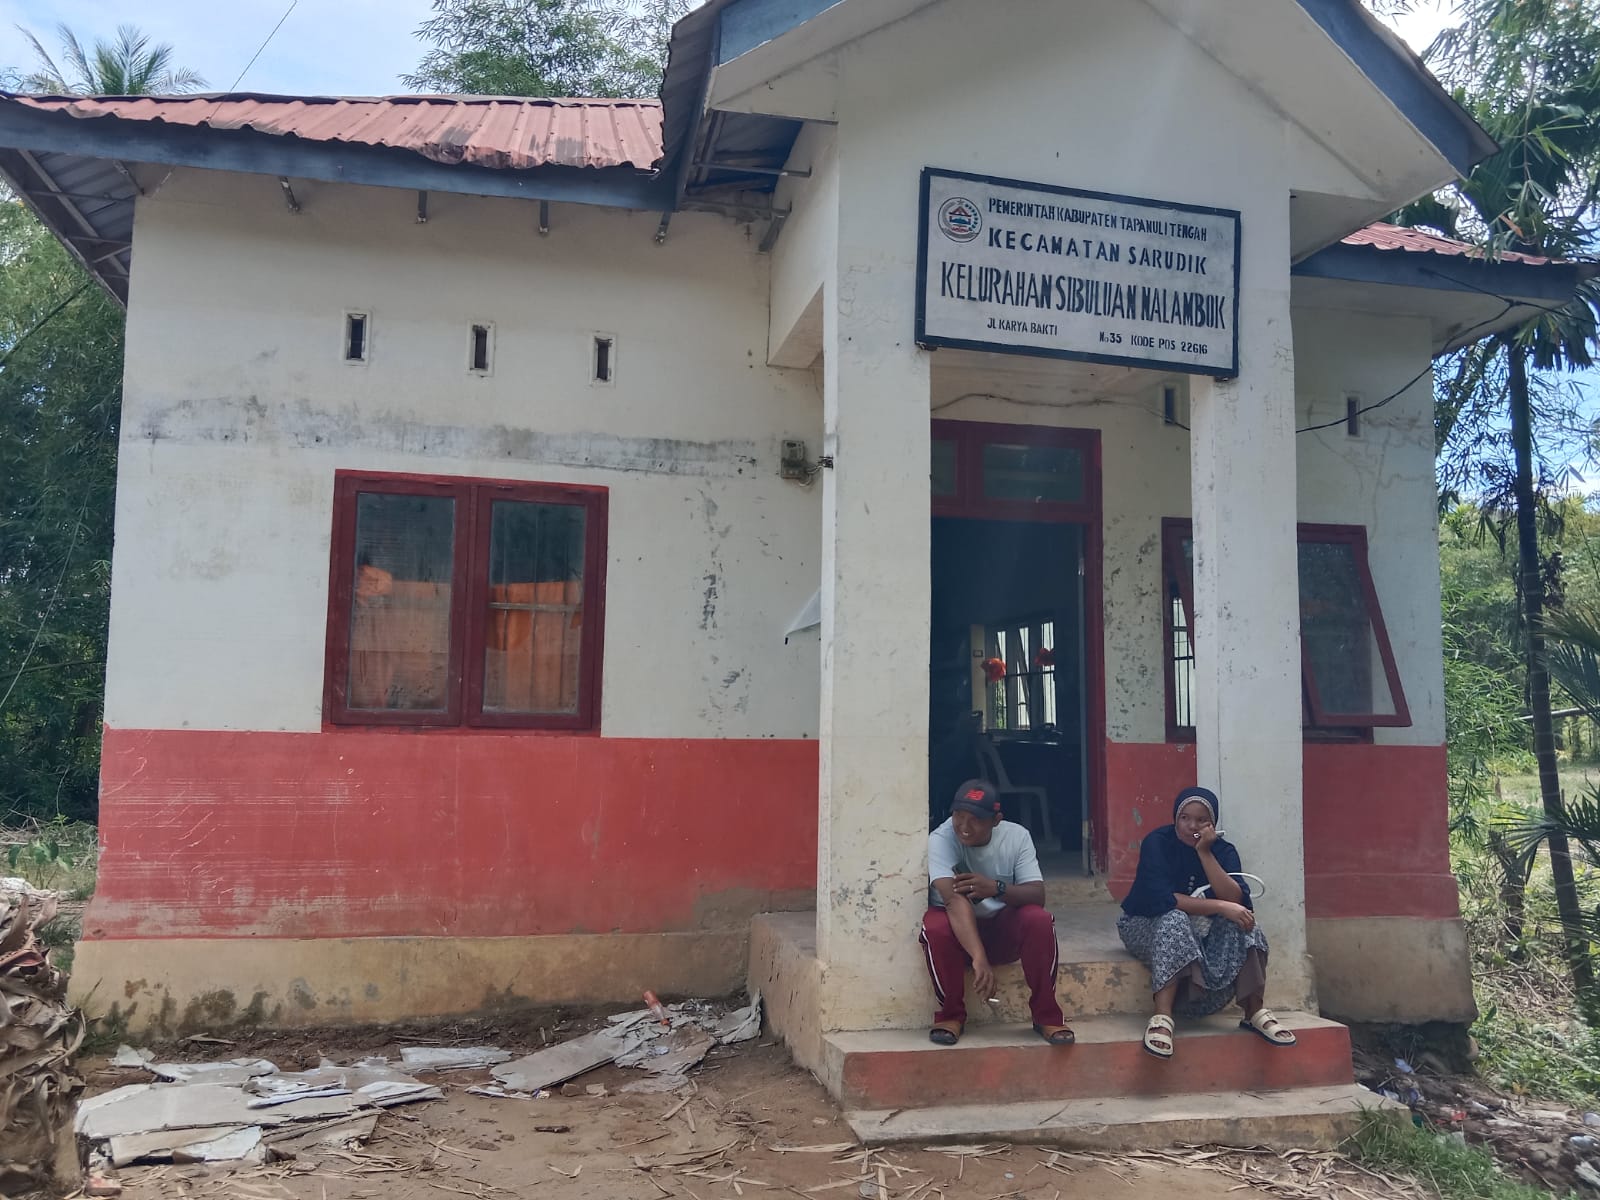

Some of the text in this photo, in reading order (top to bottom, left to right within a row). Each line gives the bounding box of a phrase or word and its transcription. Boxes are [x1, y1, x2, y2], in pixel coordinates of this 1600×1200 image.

[989, 198, 1207, 241] PEMERINTAH KABUPATEN TAPANULI TENGAH
[989, 227, 1207, 275] KECAMATAN SARUDIK
[941, 261, 1226, 329] KELURAHAN SIBULUAN NALAMBOK
[987, 318, 1058, 336] JL KARYA BAKTI
[1131, 334, 1154, 348] KODE
[1158, 339, 1176, 350] POS
[1181, 341, 1208, 355] 22616
